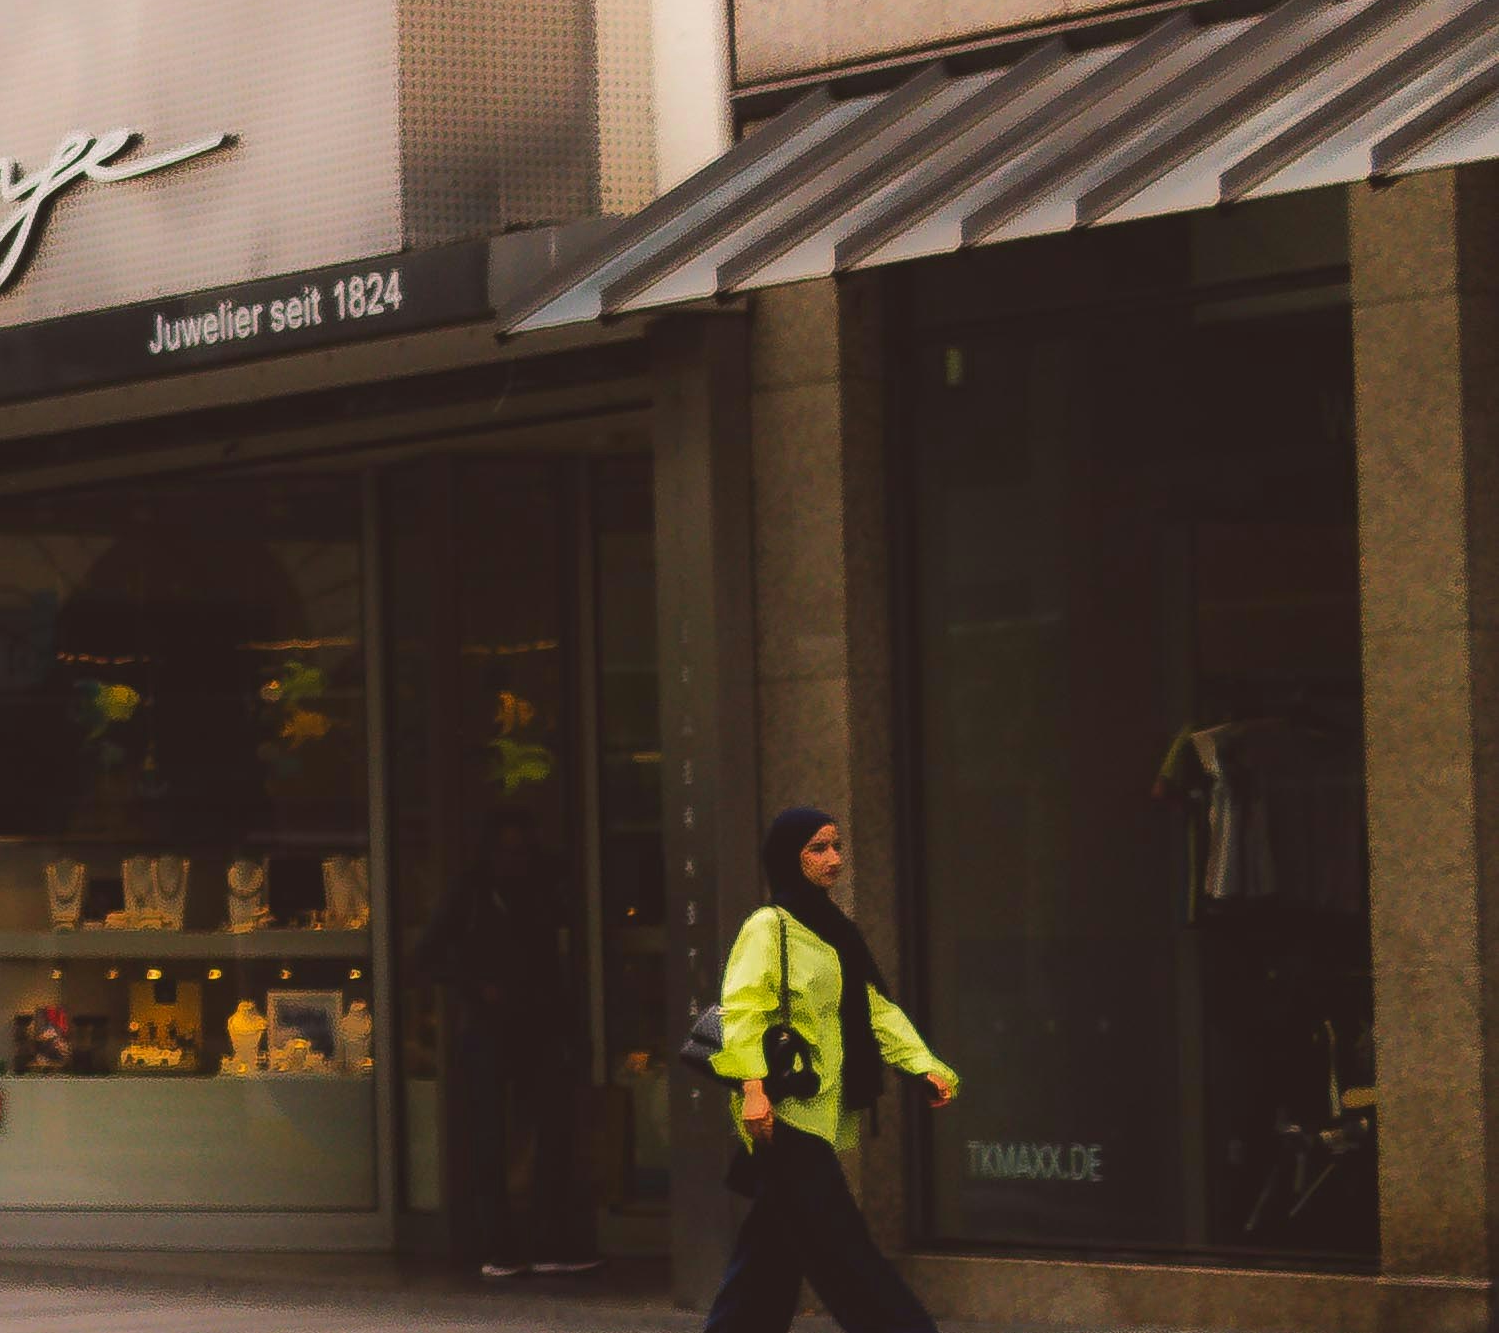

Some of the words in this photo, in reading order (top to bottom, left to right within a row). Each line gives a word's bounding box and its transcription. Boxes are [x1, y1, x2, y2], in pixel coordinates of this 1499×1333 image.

[149, 299, 263, 354] Juwelier
[270, 284, 323, 333] seit
[333, 268, 403, 321] 1824
